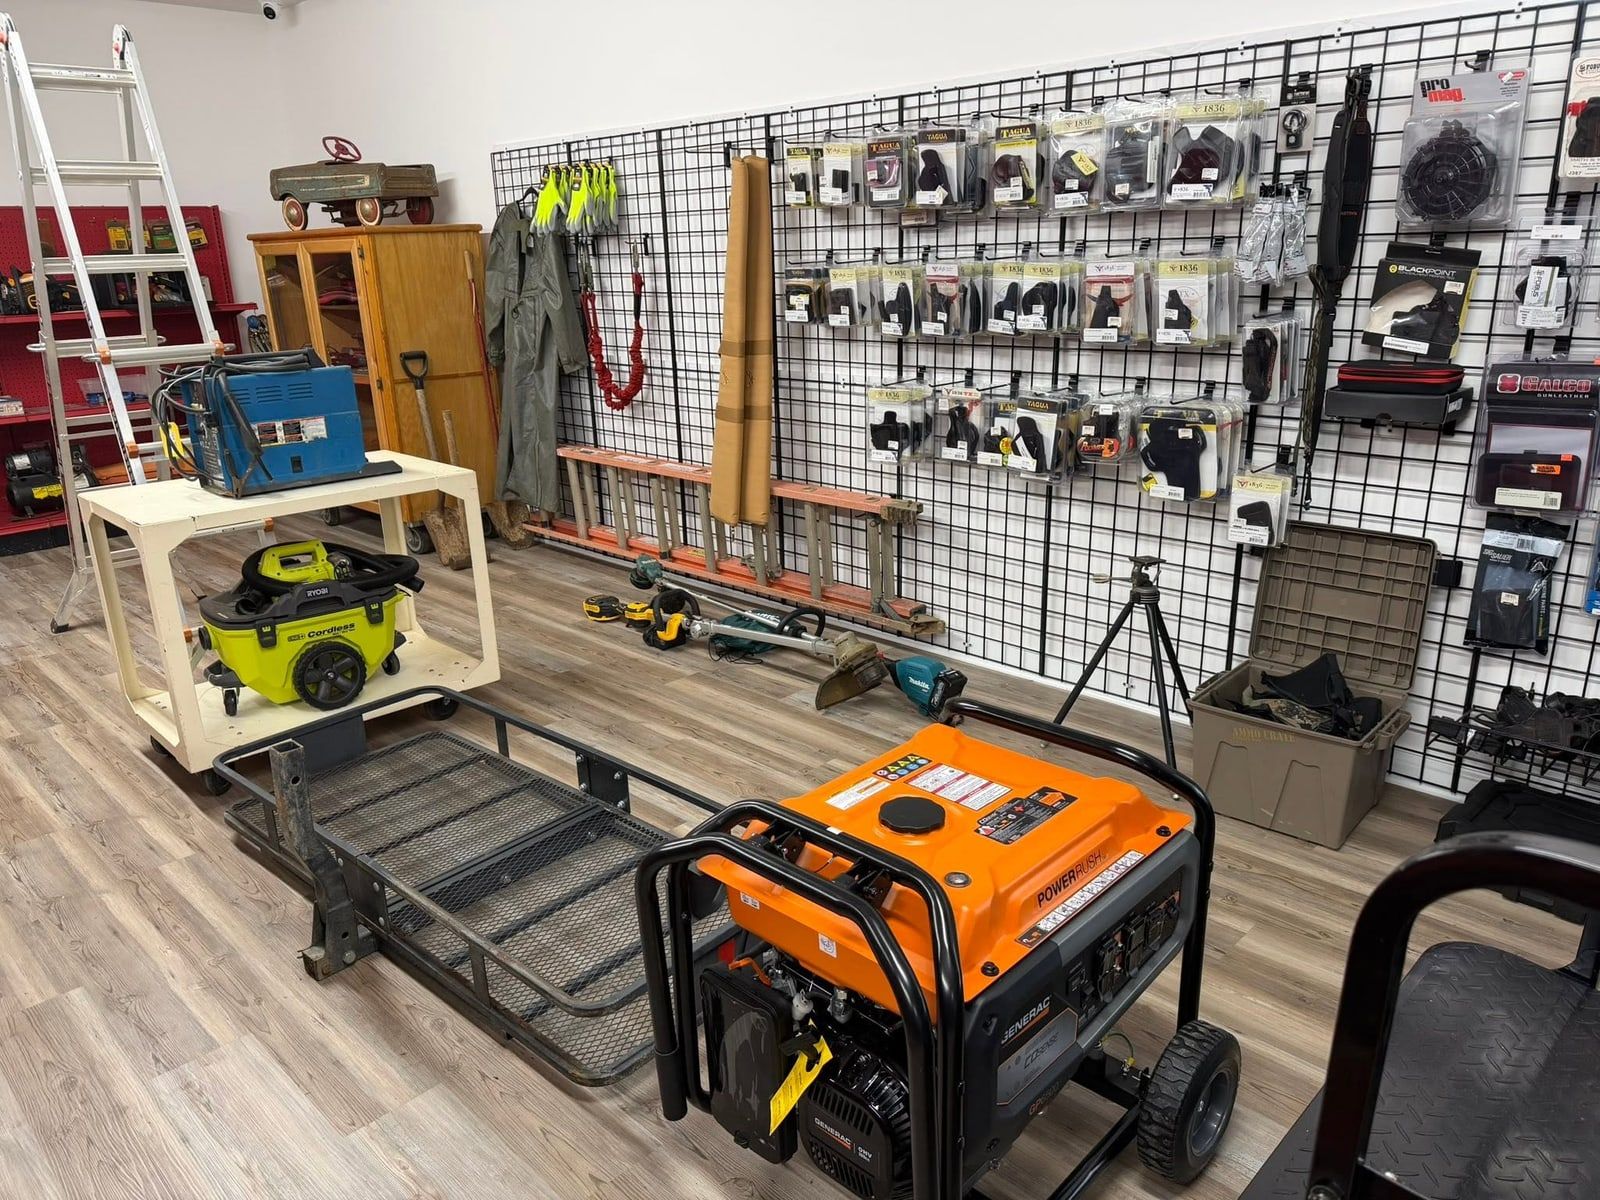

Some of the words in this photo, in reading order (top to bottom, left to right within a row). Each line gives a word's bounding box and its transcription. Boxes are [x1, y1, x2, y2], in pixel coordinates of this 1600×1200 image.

[1420, 78, 1450, 98] pro
[1203, 104, 1225, 112] 1836
[1074, 119, 1092, 127] 1836
[1001, 127, 1031, 138] TAGUA
[871, 142, 900, 152] TAGUA
[1399, 265, 1456, 276] BLACKPOINT
[1521, 376, 1592, 392] GALCO
[307, 587, 328, 597] RYOBI
[308, 623, 355, 637] Cordless
[814, 1117, 851, 1145] GENERAC
